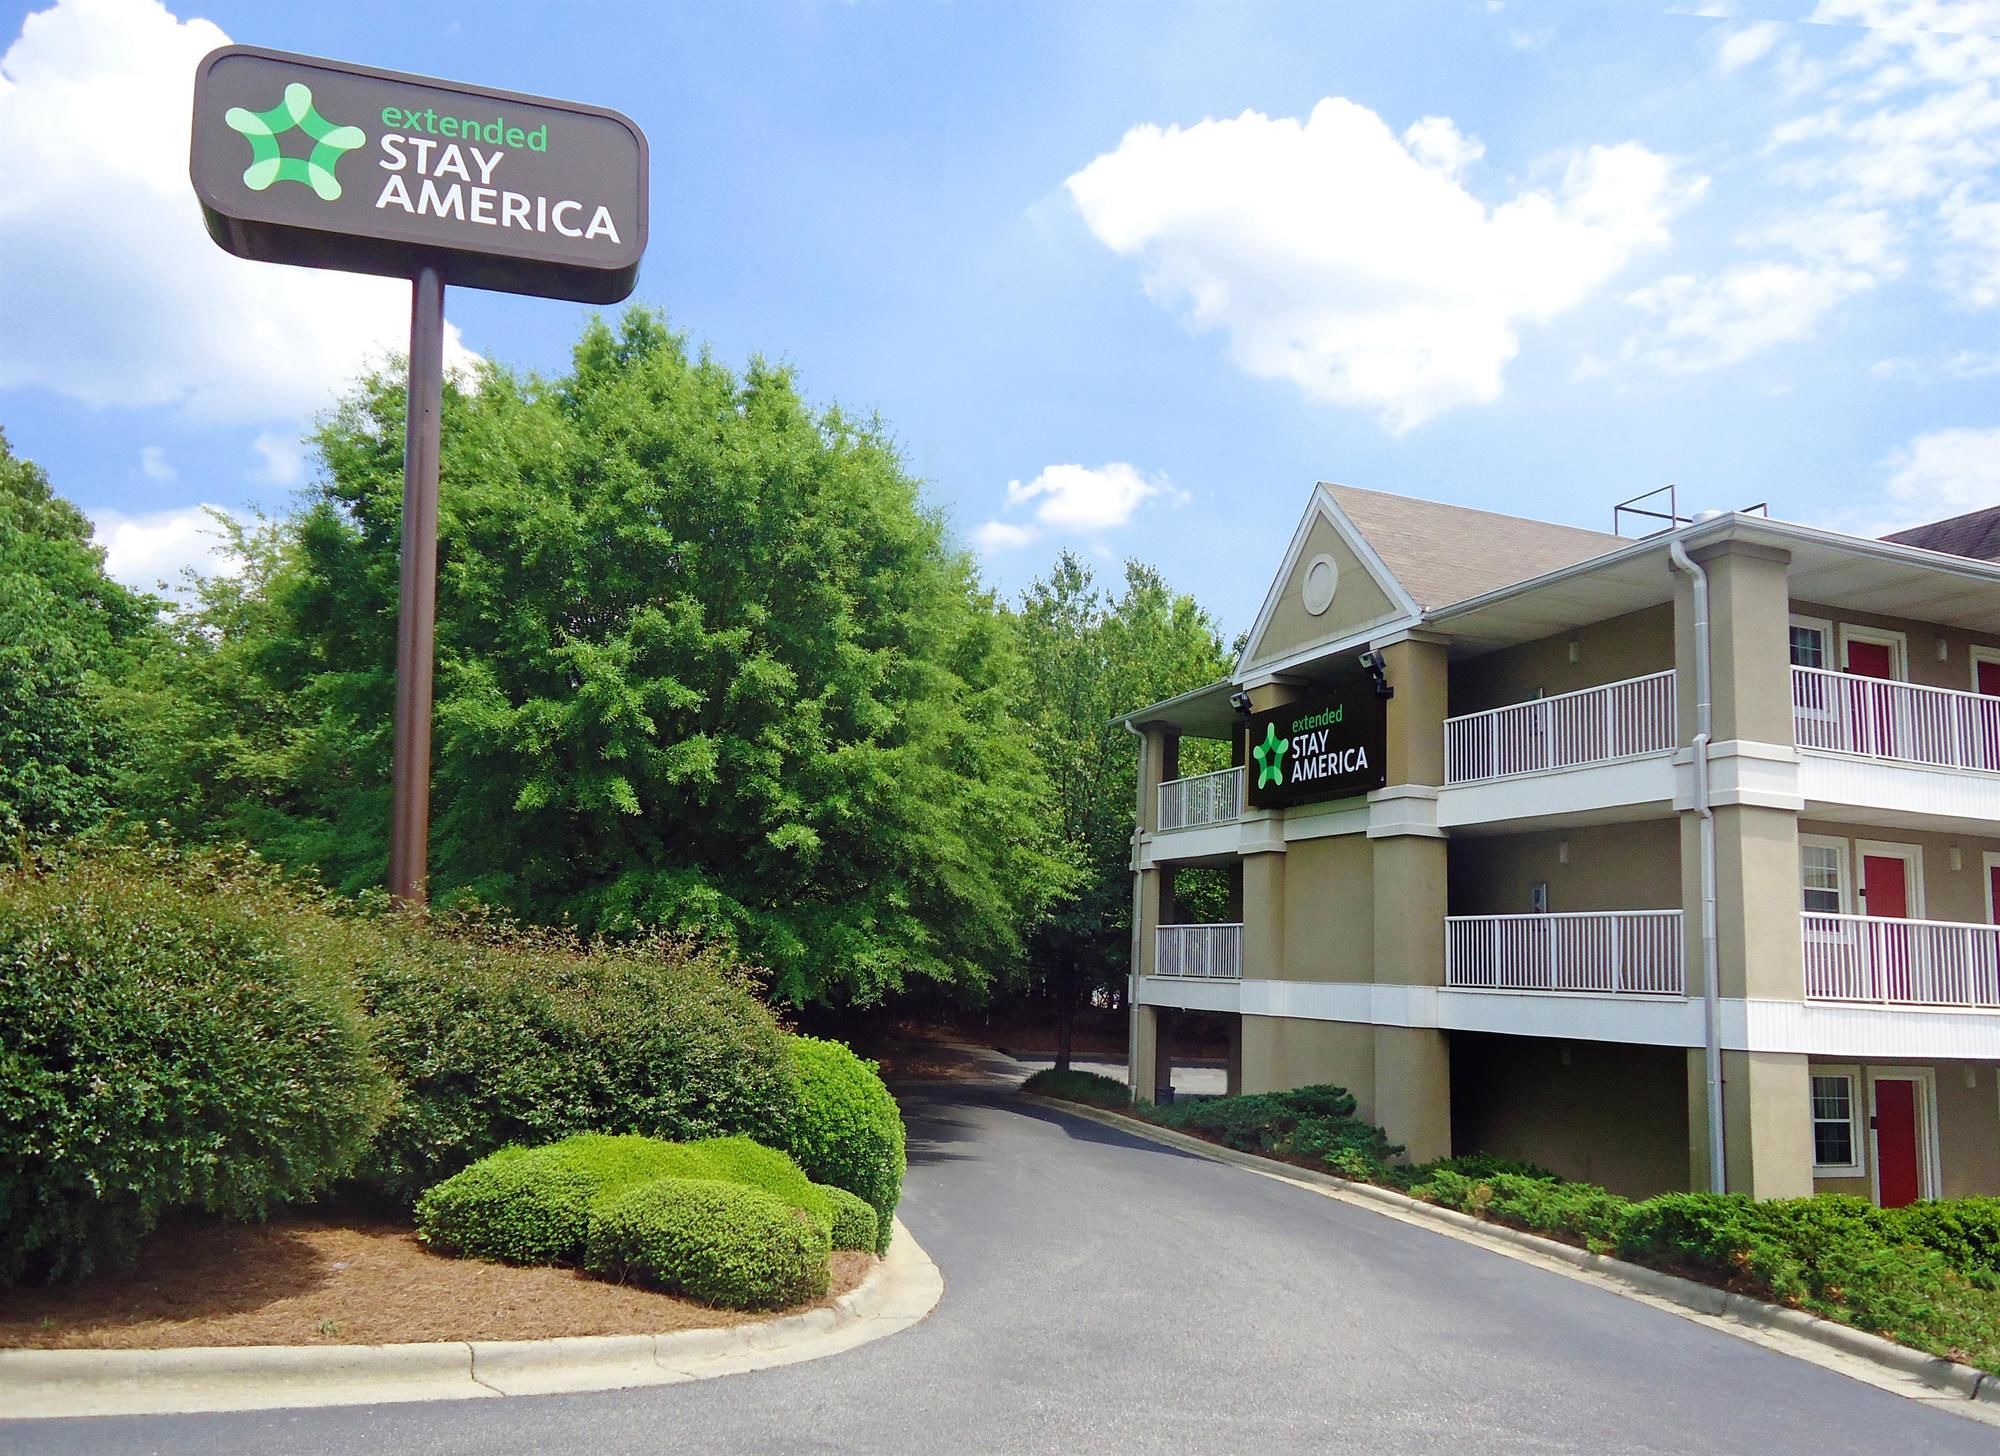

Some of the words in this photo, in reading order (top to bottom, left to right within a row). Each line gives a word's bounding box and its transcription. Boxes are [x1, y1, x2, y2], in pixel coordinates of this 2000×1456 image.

[381, 106, 547, 152] extended
[379, 133, 504, 185] STAY
[375, 174, 621, 244] AMERICA
[1292, 704, 1343, 733] extended
[1291, 729, 1329, 759] STAY
[1291, 746, 1368, 783] AMERICA
